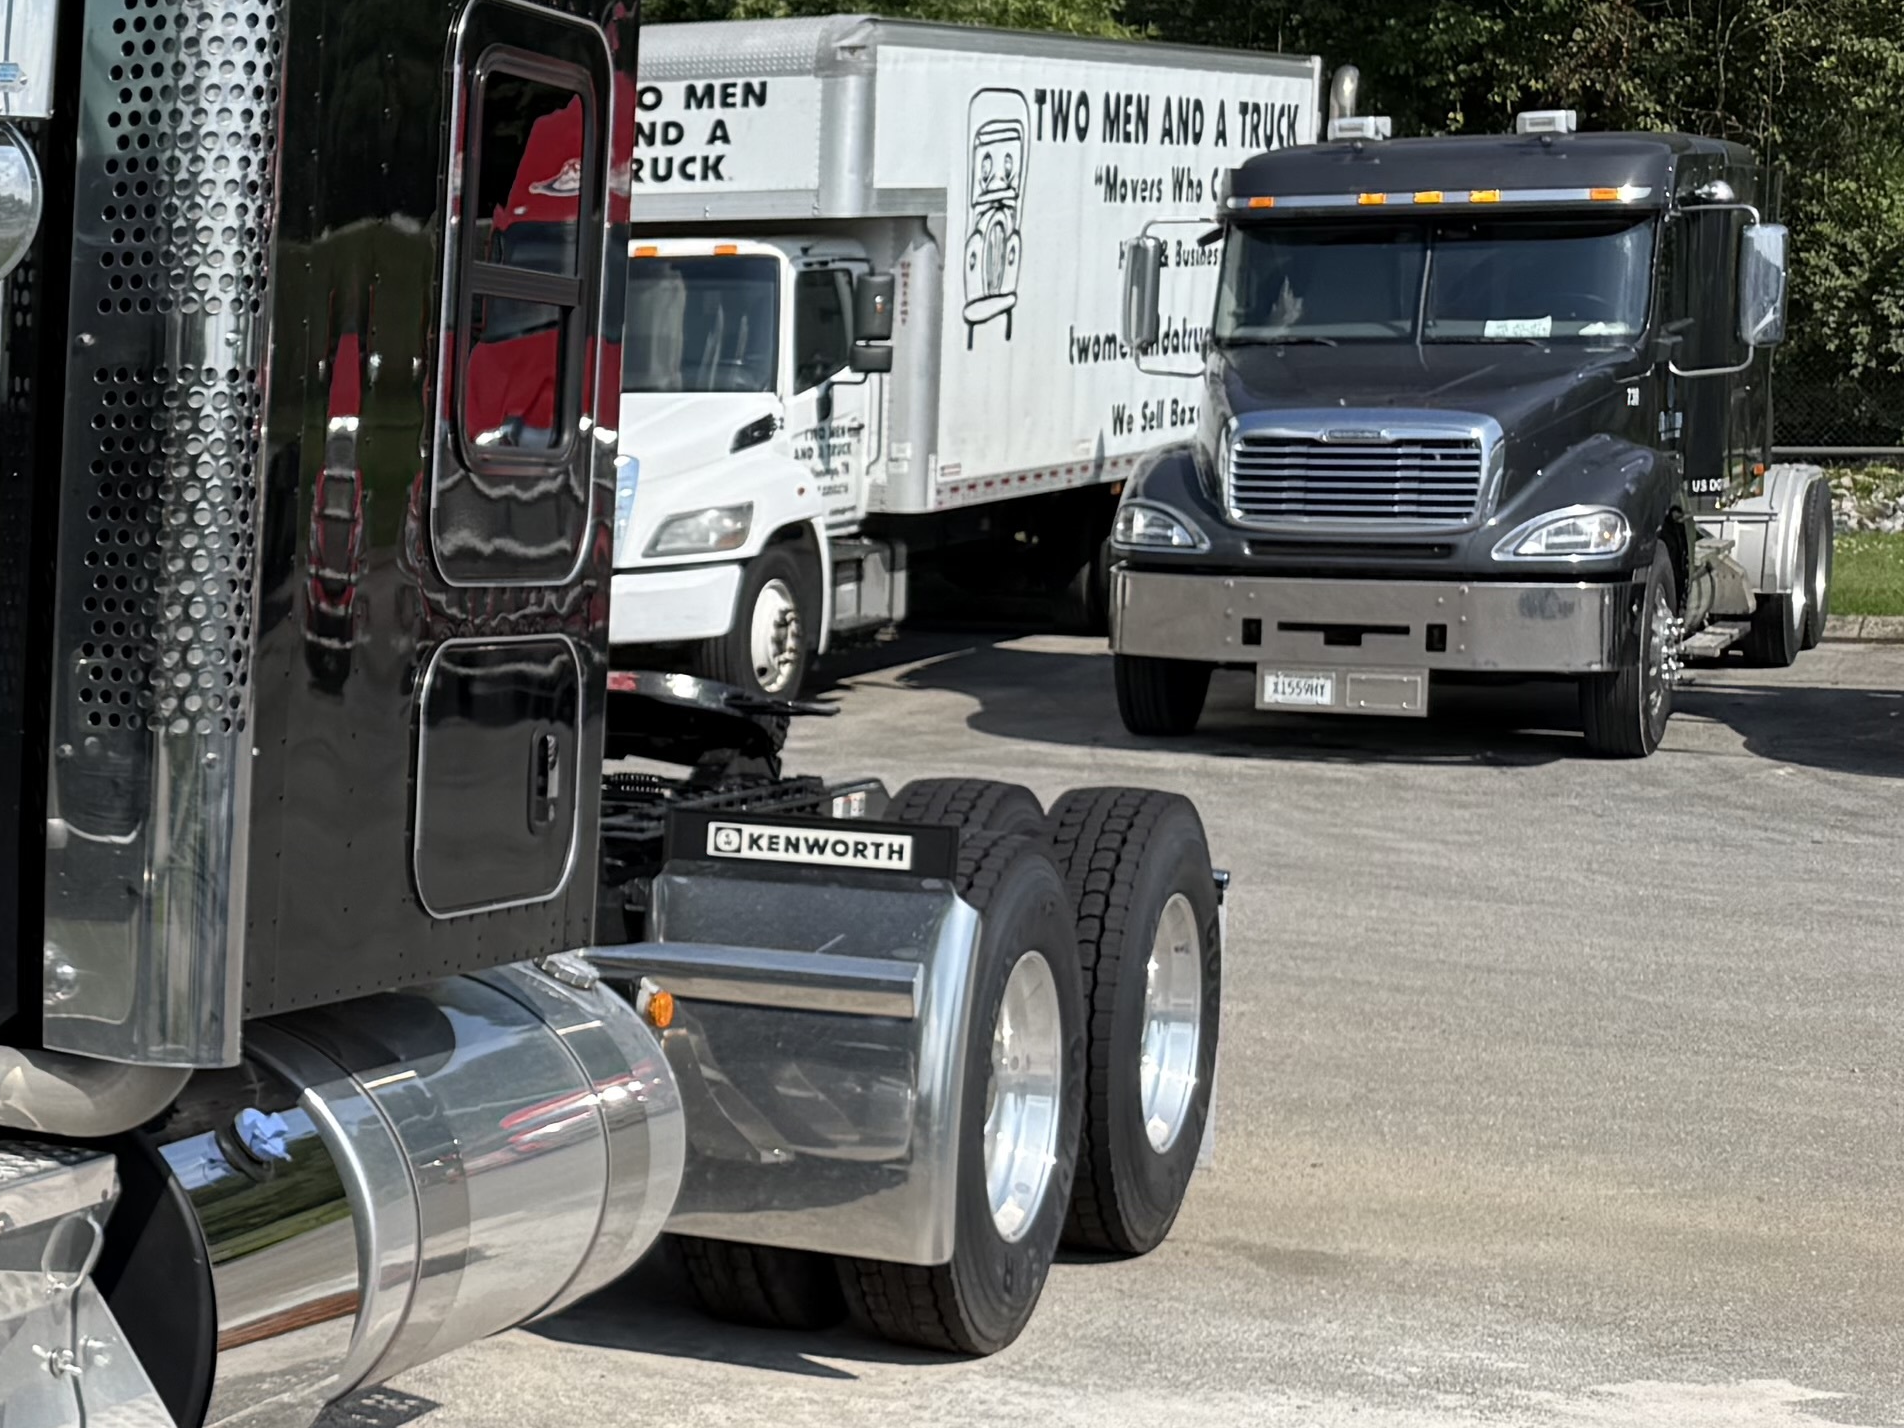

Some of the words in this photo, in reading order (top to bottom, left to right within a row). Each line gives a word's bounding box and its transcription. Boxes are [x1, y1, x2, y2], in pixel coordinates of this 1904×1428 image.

[684, 80, 768, 110] MEN
[634, 121, 685, 148] ND
[705, 118, 732, 146] A
[1034, 88, 1090, 143] TWO
[1102, 90, 1150, 145] MEN
[1160, 95, 1205, 146] AND
[1214, 98, 1228, 148] A
[1239, 101, 1299, 152] TRUCK
[632, 154, 726, 184] RUCK
[1171, 166, 1203, 203] Who
[1112, 403, 1134, 437] We
[1141, 399, 1165, 432] Sell
[747, 832, 905, 861] KENWORTH
